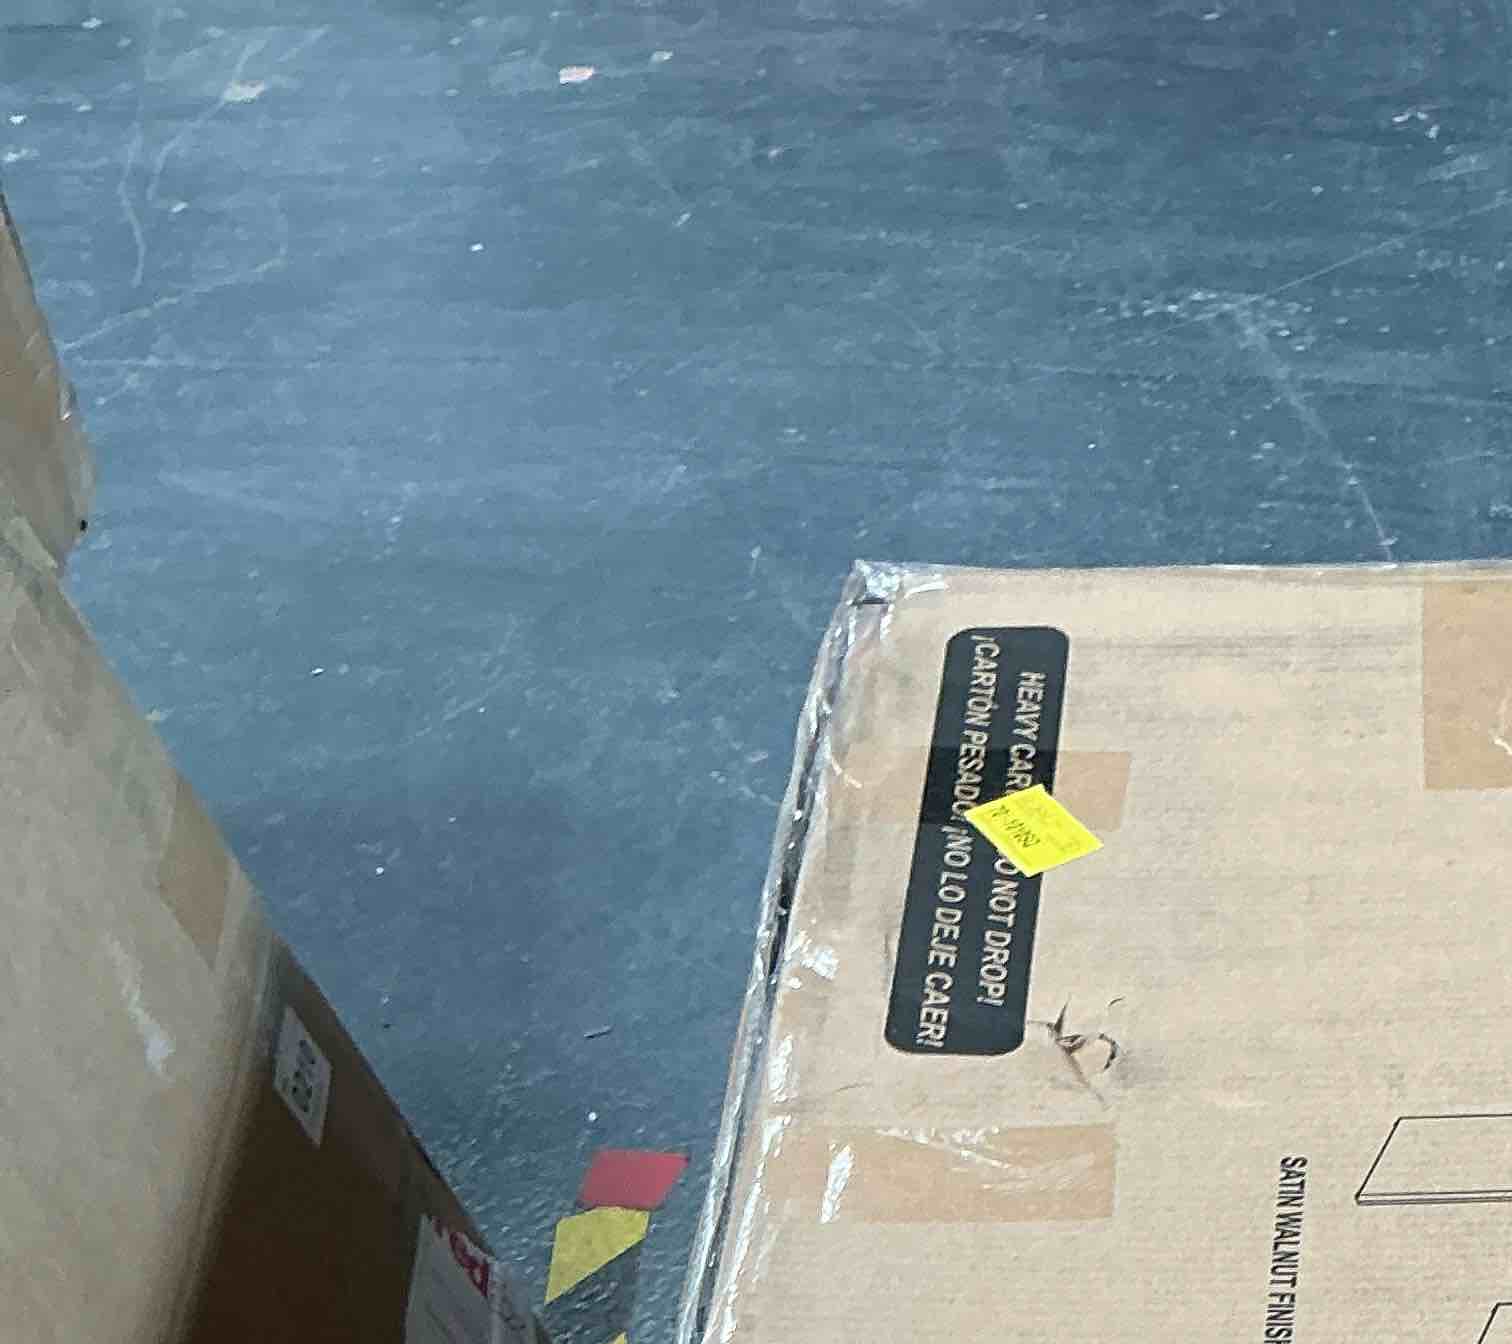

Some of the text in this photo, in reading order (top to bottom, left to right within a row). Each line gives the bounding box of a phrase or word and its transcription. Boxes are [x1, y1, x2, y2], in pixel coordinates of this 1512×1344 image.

[1011, 672, 1046, 741] HEAVY
[938, 873, 967, 902] LO
[990, 880, 1016, 927] NOT
[927, 908, 963, 967] DEJE
[976, 930, 1012, 1006] DROP!
[915, 972, 955, 1047] CAER!
[1276, 1156, 1307, 1208] SATIN
[1270, 1212, 1303, 1287] WALNUT
